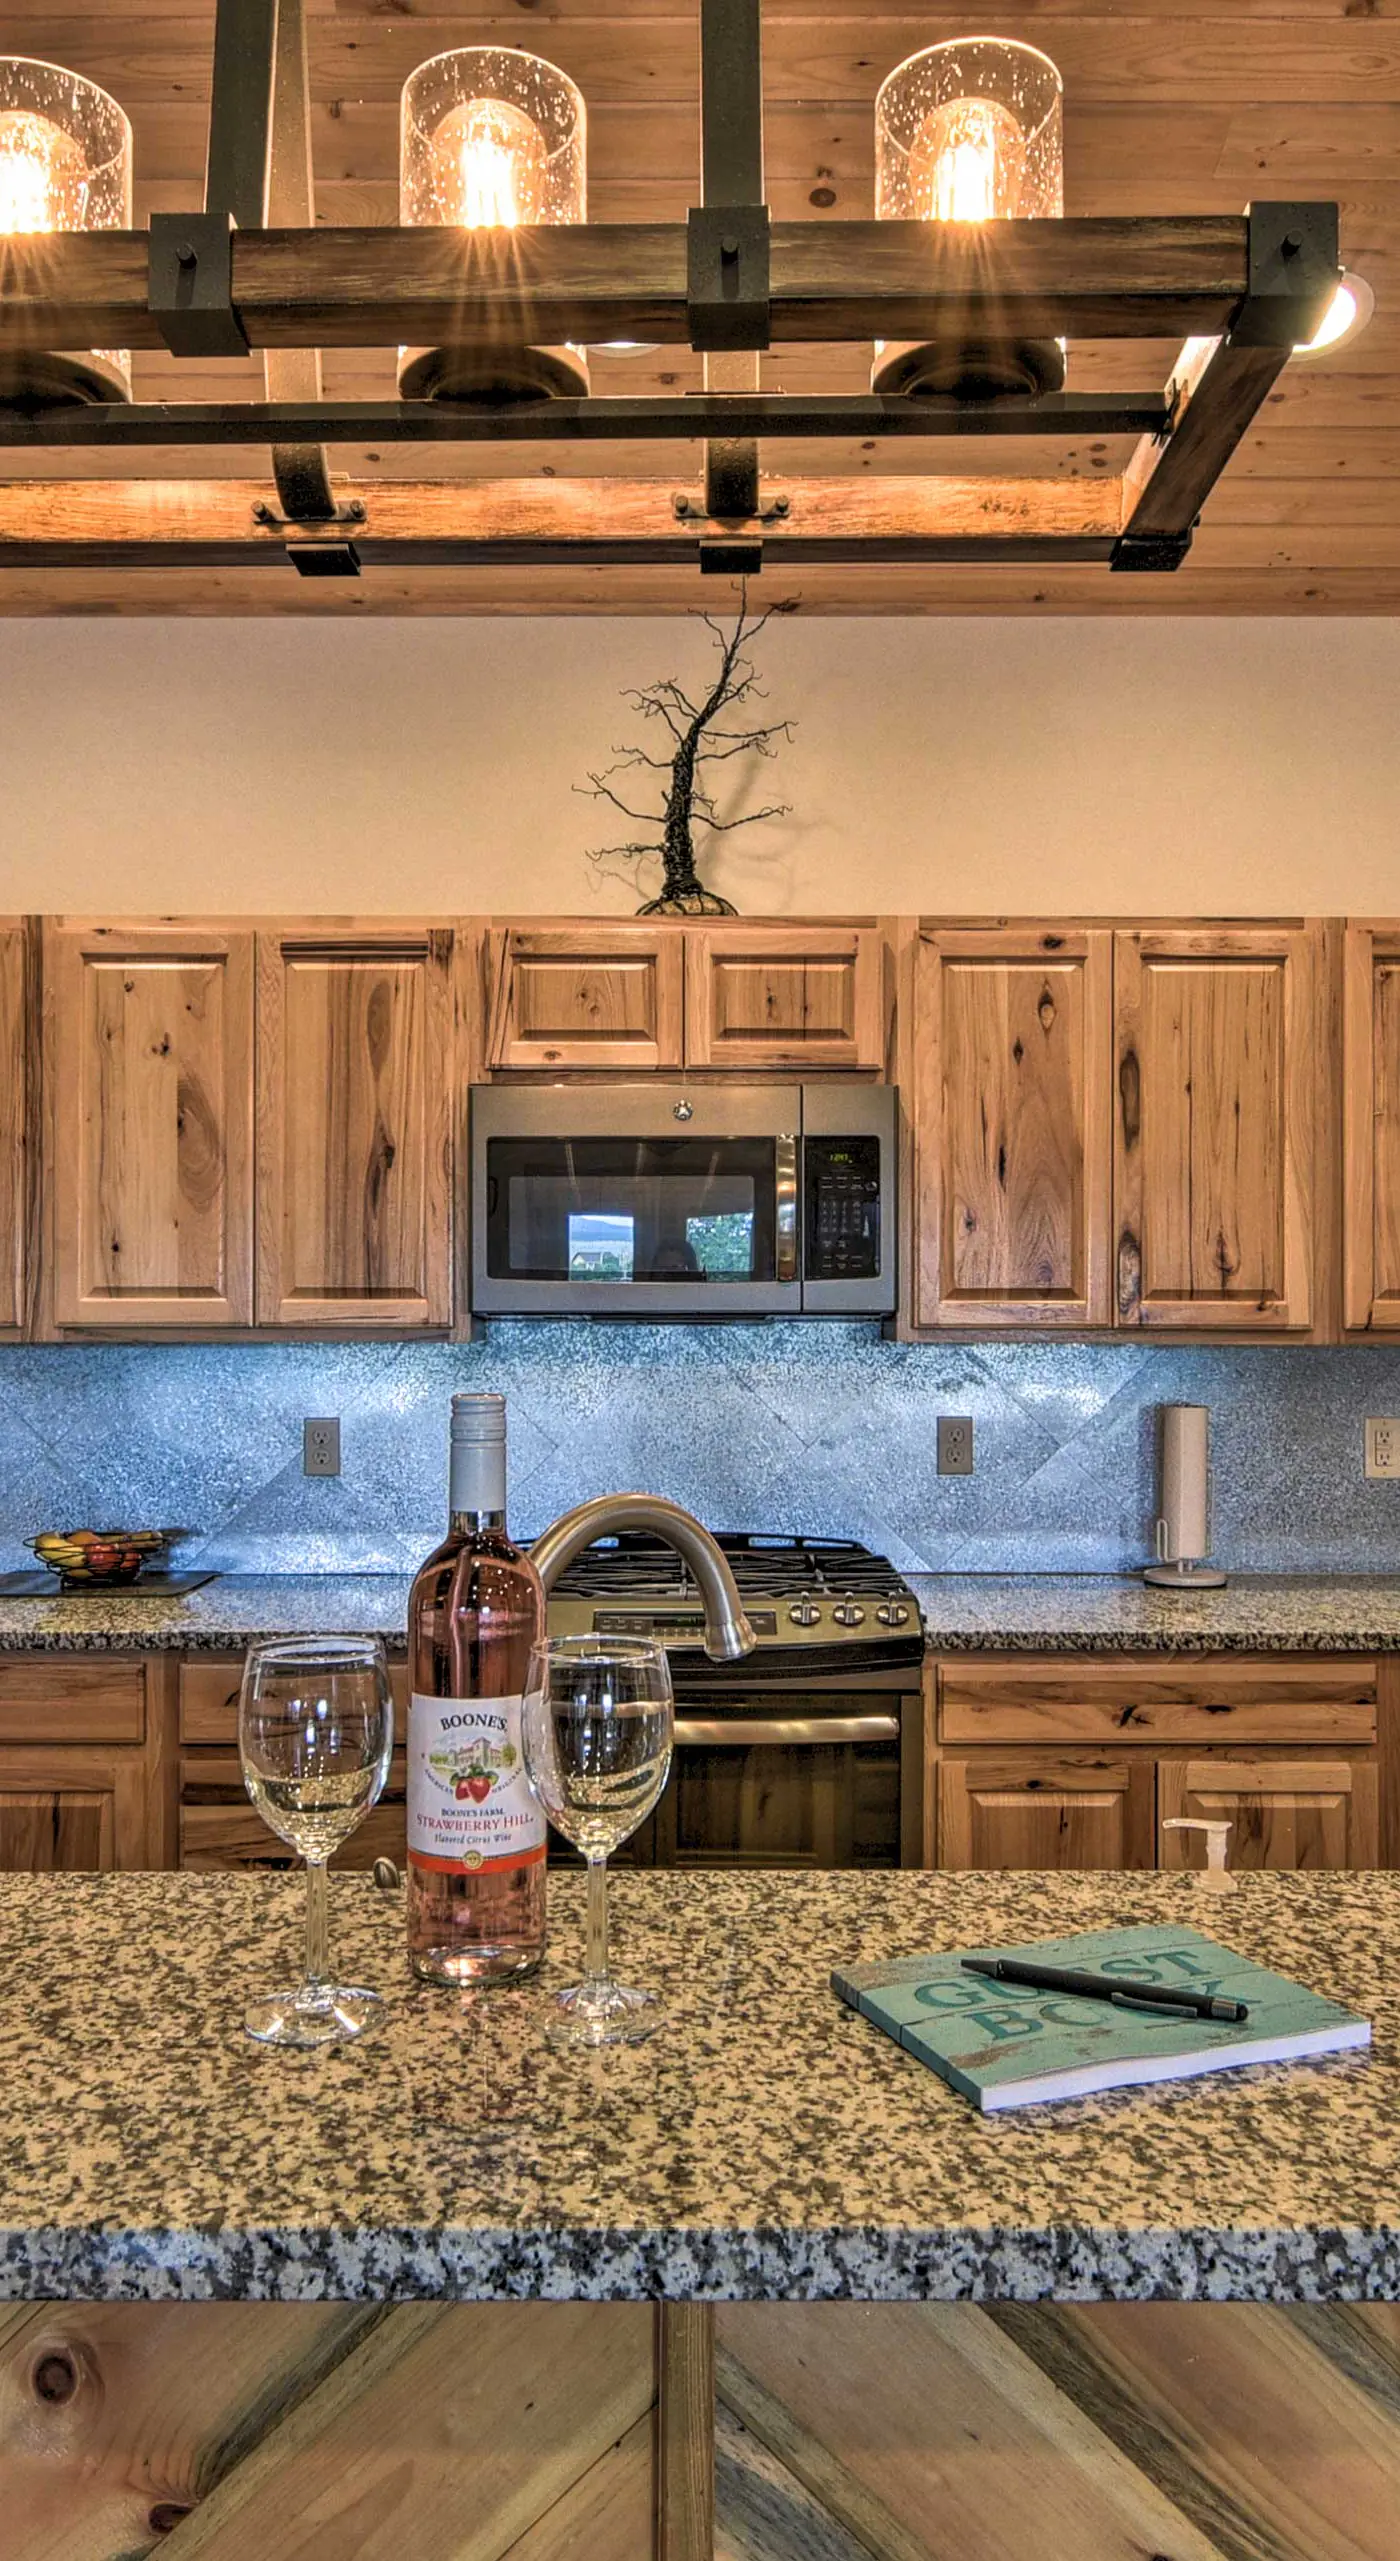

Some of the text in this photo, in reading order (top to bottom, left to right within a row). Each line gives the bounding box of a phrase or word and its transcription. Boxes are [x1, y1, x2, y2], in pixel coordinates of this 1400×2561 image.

[440, 1713, 508, 1731] BOONE'S
[417, 1813, 531, 1831] STRAWBERRY HILL
[914, 1950, 1211, 2009] GUST
